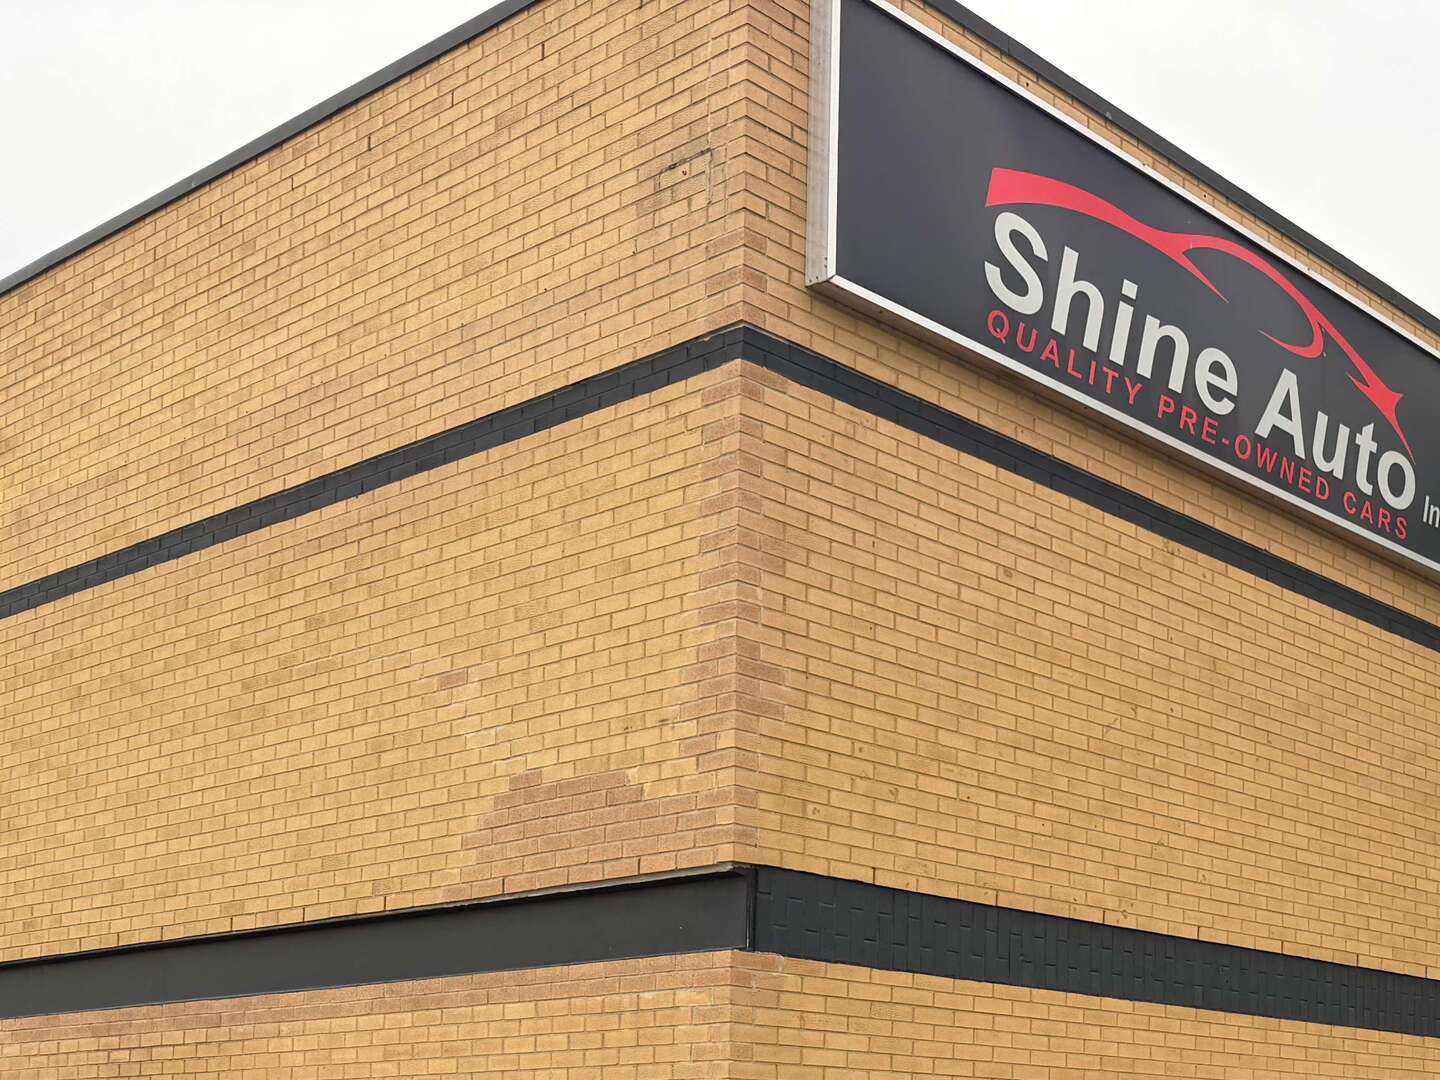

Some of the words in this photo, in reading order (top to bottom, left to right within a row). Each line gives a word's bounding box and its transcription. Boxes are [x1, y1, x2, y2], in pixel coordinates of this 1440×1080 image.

[985, 212, 1238, 416] Shine
[1255, 367, 1416, 510] Auto
[986, 310, 1143, 405] QUALITY
[1158, 393, 1331, 501] PRE-OWNED
[1343, 490, 1409, 540] CARS
